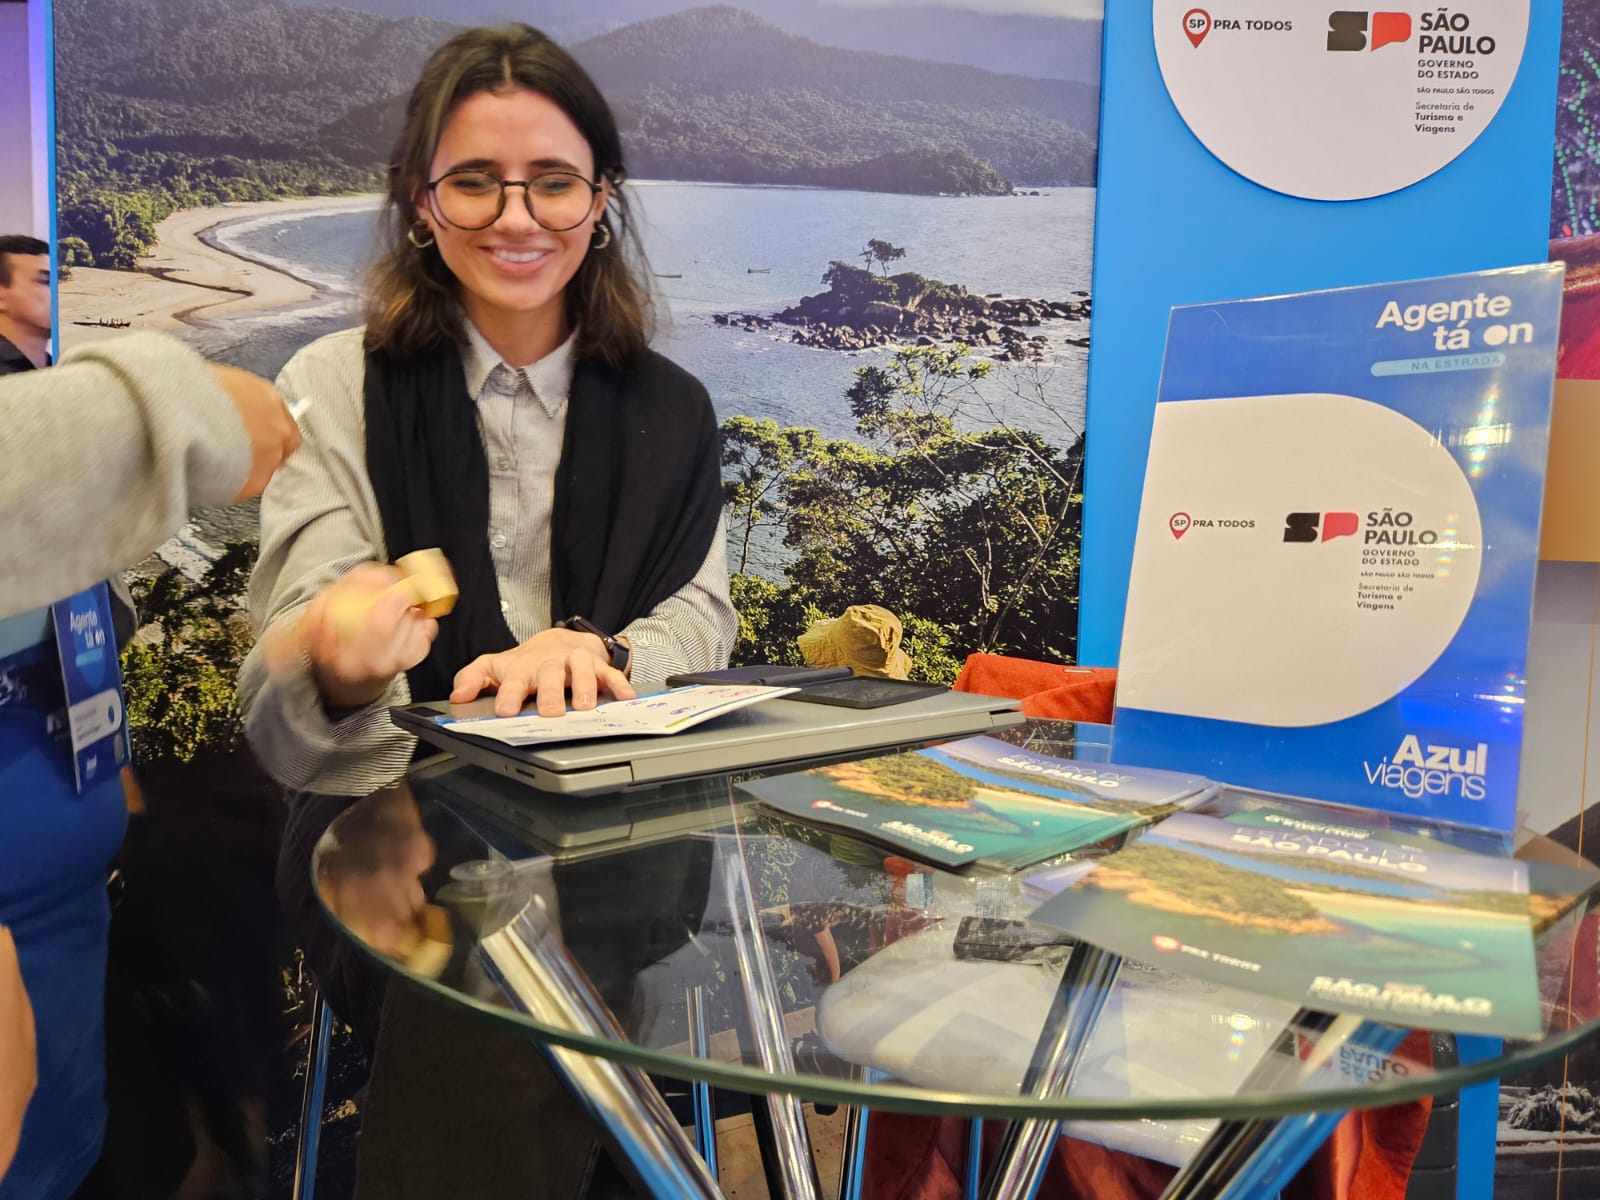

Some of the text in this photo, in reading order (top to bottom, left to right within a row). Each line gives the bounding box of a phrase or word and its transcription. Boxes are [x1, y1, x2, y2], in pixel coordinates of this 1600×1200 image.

[1189, 19, 1292, 31] SP PRA TODOS
[1420, 8, 1469, 32] SÃO
[1418, 35, 1496, 55] PAULO
[1417, 59, 1474, 69] GOVERNO
[1417, 70, 1479, 80] DO ESTADO
[1415, 101, 1474, 111] Secretaria de
[1415, 112, 1454, 121] Turismo
[1415, 124, 1455, 134] Viagens
[1375, 292, 1512, 332] Agente
[1433, 320, 1534, 351] tá on
[1411, 356, 1500, 371] NA ESTRADA
[1366, 507, 1413, 527] SÃO
[1192, 519, 1214, 528] PRA
[1218, 519, 1256, 528] TODOS
[1364, 530, 1438, 546] PAULO
[1362, 549, 1415, 557] GOVERNO
[1362, 558, 1420, 566] DO ESTADO
[1358, 582, 1414, 592] Secretaria de
[1358, 591, 1394, 600] Turismo
[1356, 601, 1394, 611] Viagens
[1391, 734, 1488, 776] Azul
[1363, 756, 1486, 800] viagens
[1306, 844, 1428, 873] PAULO
